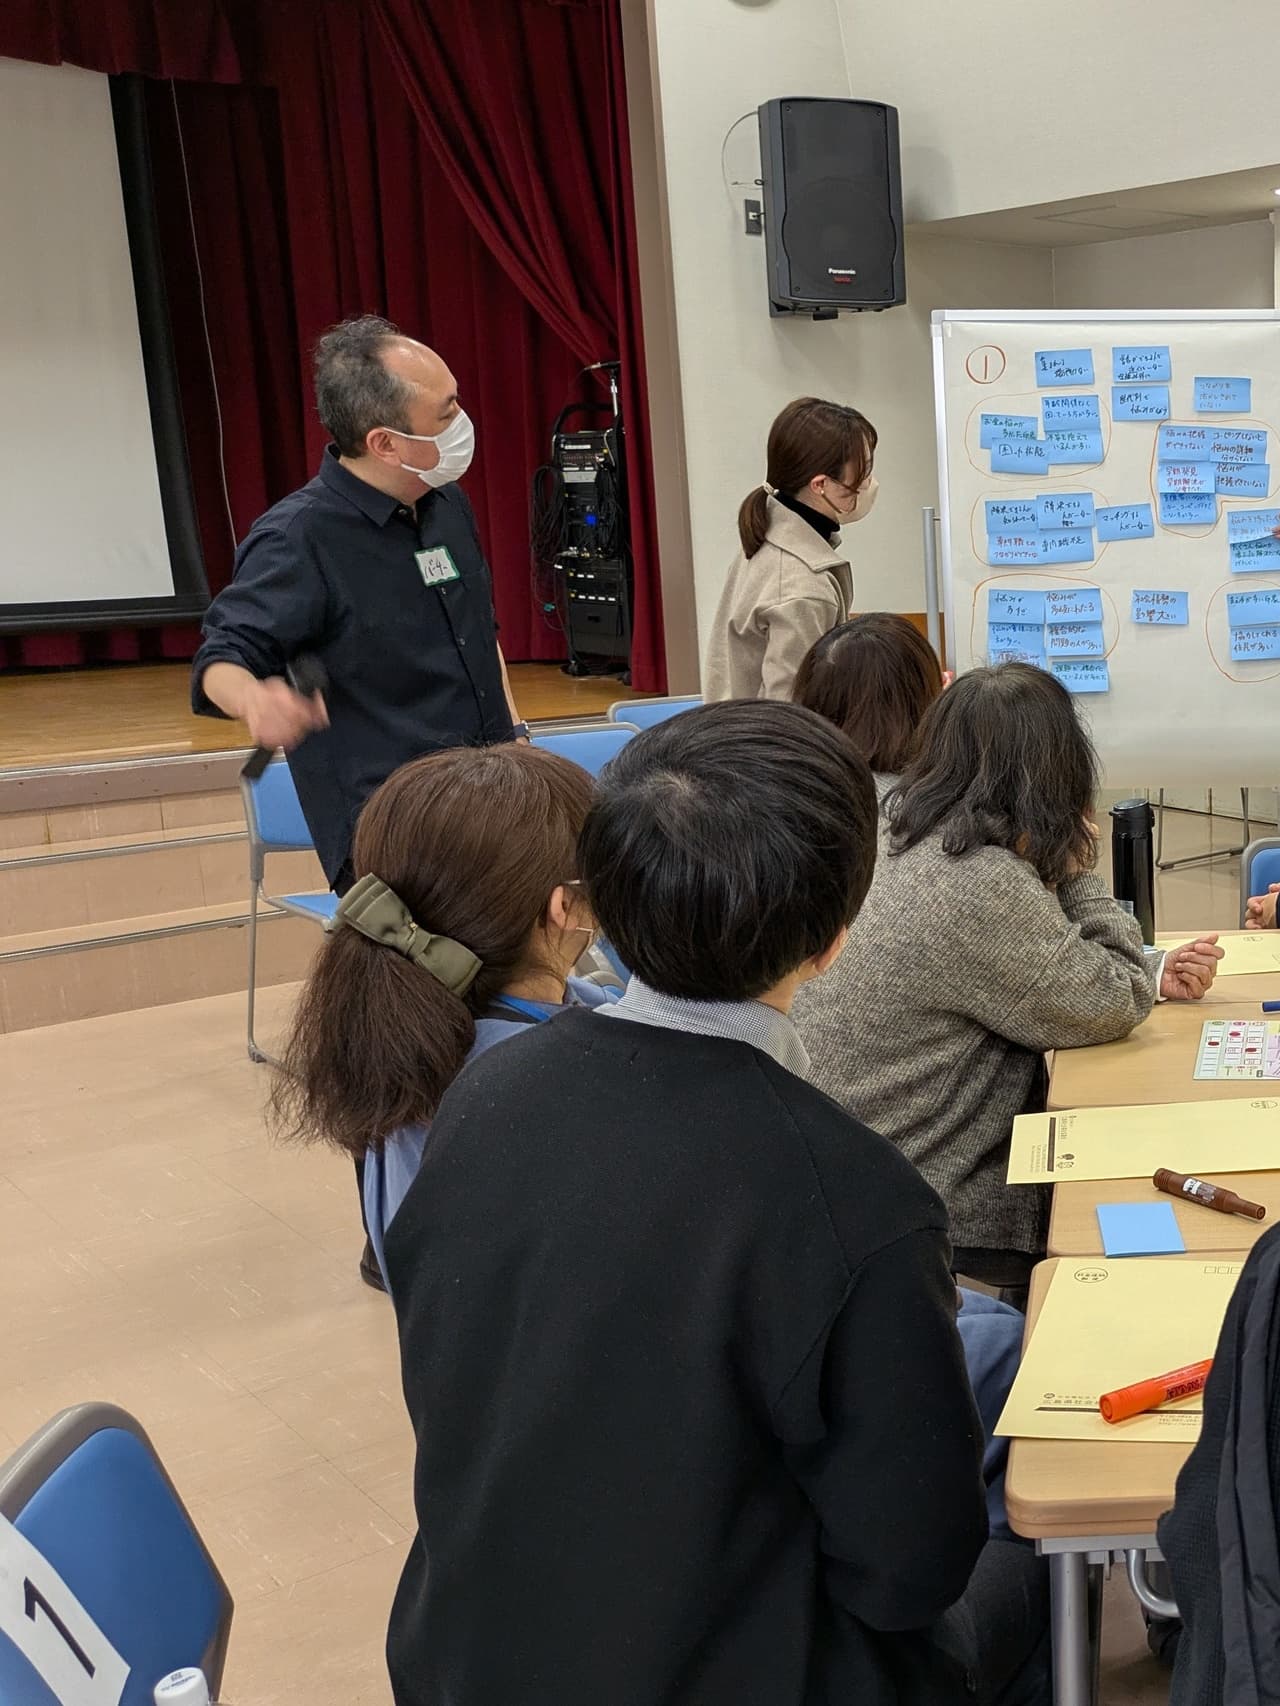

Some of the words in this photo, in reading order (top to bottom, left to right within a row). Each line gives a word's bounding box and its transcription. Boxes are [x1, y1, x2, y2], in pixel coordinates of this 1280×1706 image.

[1135, 593, 1176, 605] 社会情勢の
[24, 1576, 96, 1679] 1
